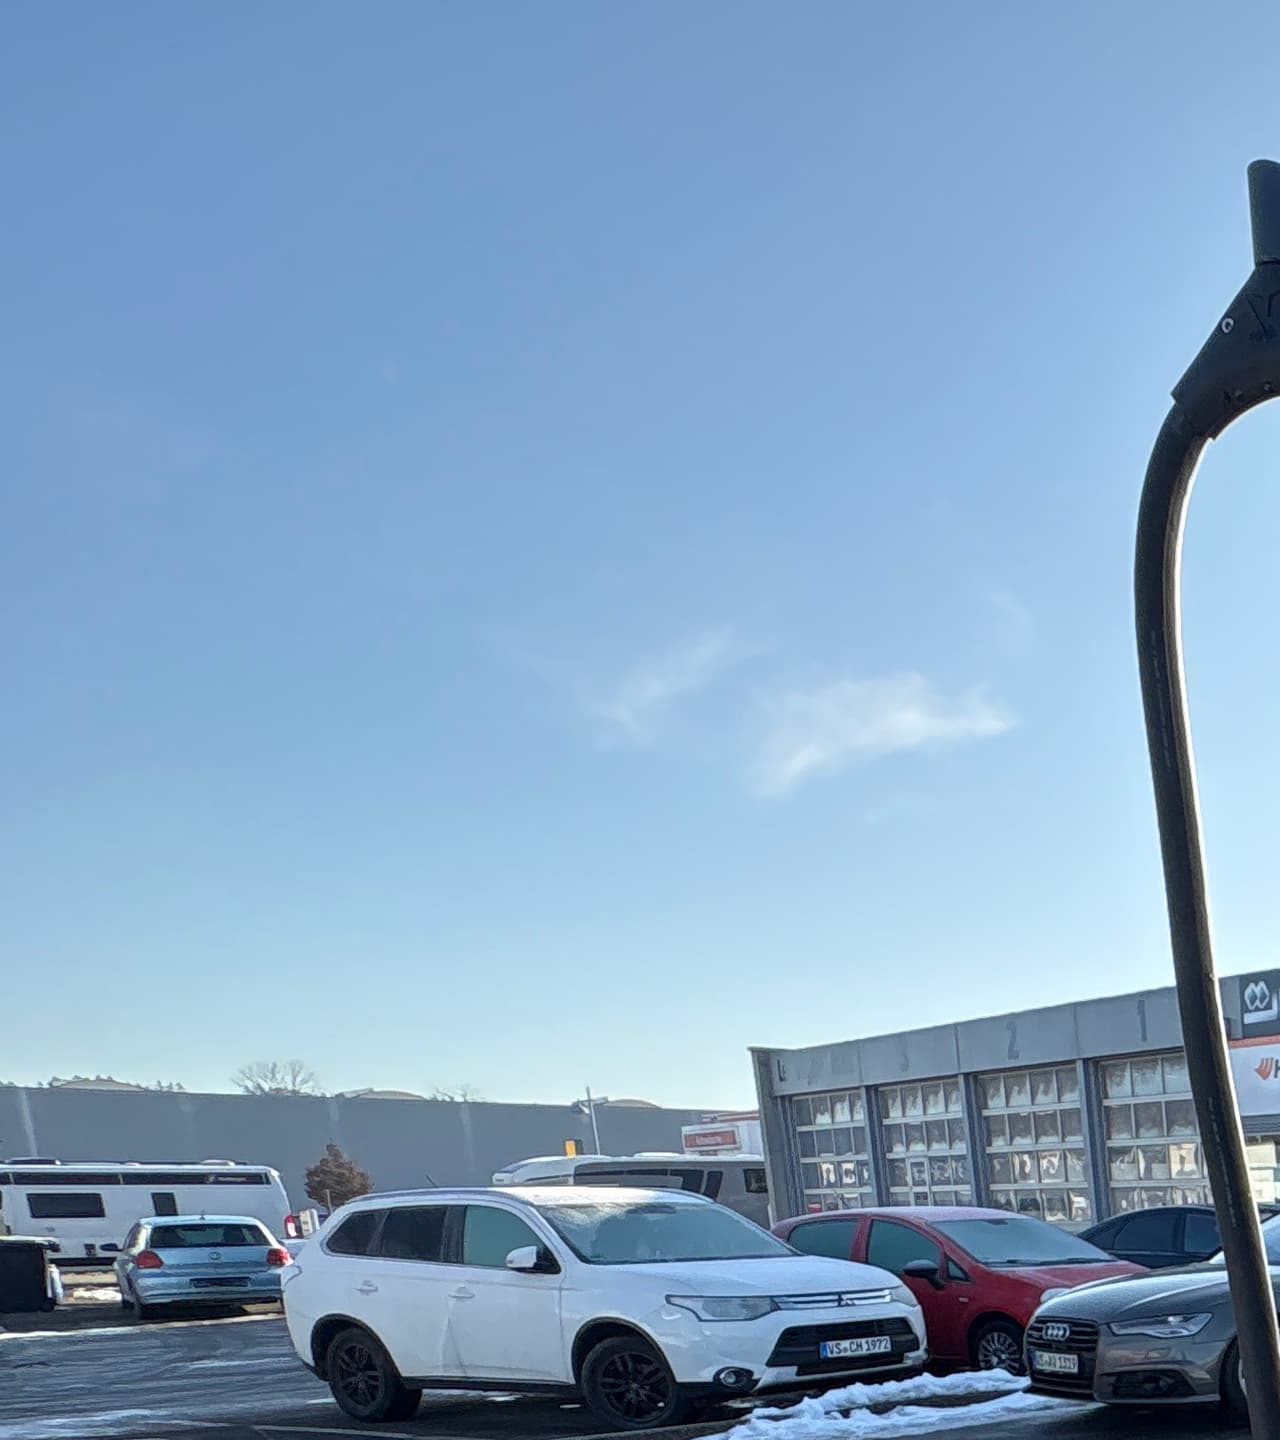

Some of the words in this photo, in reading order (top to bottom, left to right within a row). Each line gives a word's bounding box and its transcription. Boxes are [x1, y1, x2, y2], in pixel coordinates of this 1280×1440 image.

[1006, 1022, 1020, 1060] 2
[828, 1340, 842, 1354] VS
[850, 1340, 864, 1353] CH
[865, 1338, 890, 1352] 1972
